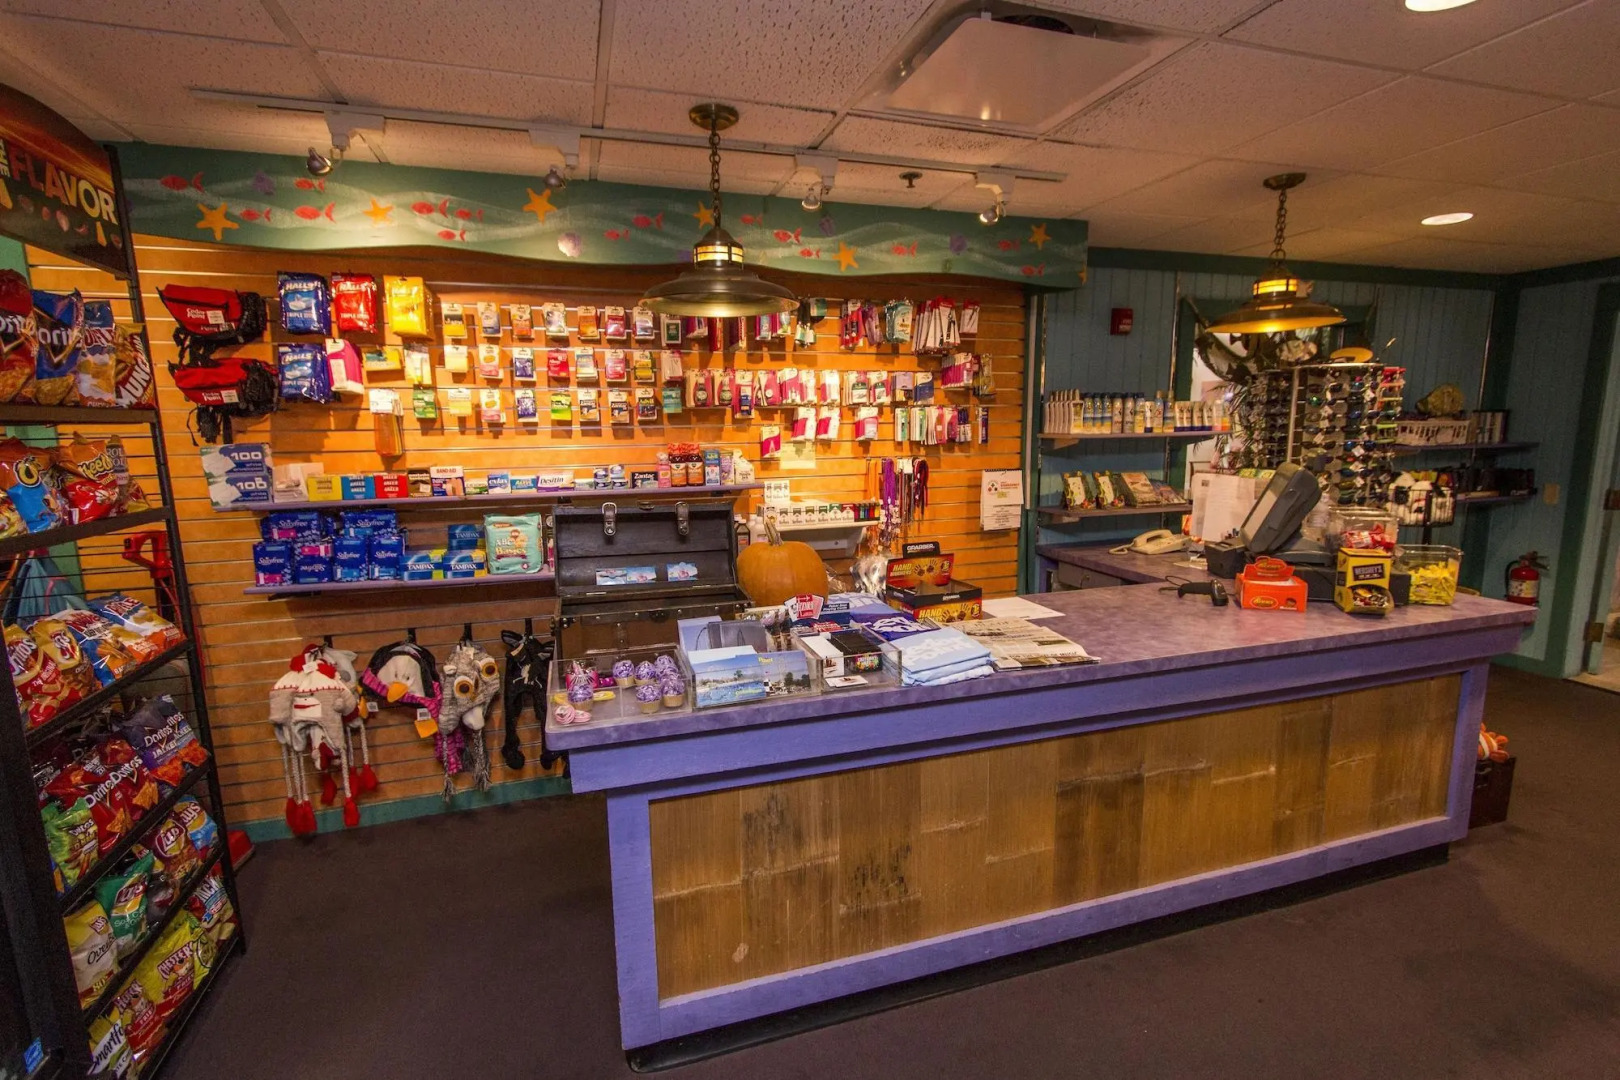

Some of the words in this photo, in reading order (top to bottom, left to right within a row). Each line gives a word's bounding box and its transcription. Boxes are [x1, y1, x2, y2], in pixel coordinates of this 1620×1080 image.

[9, 141, 118, 225] FLAVOR
[231, 451, 262, 460] 100
[279, 520, 308, 529] Stayfree
[356, 520, 385, 528] Stayfree
[336, 552, 360, 560] Stayfree
[374, 551, 398, 559] Stayfree
[258, 557, 285, 565] Stayfree
[892, 563, 912, 571] HAND
[1354, 566, 1382, 575] HERSHEY'S
[144, 725, 173, 748] Doritos
[109, 755, 143, 785] Doritos
